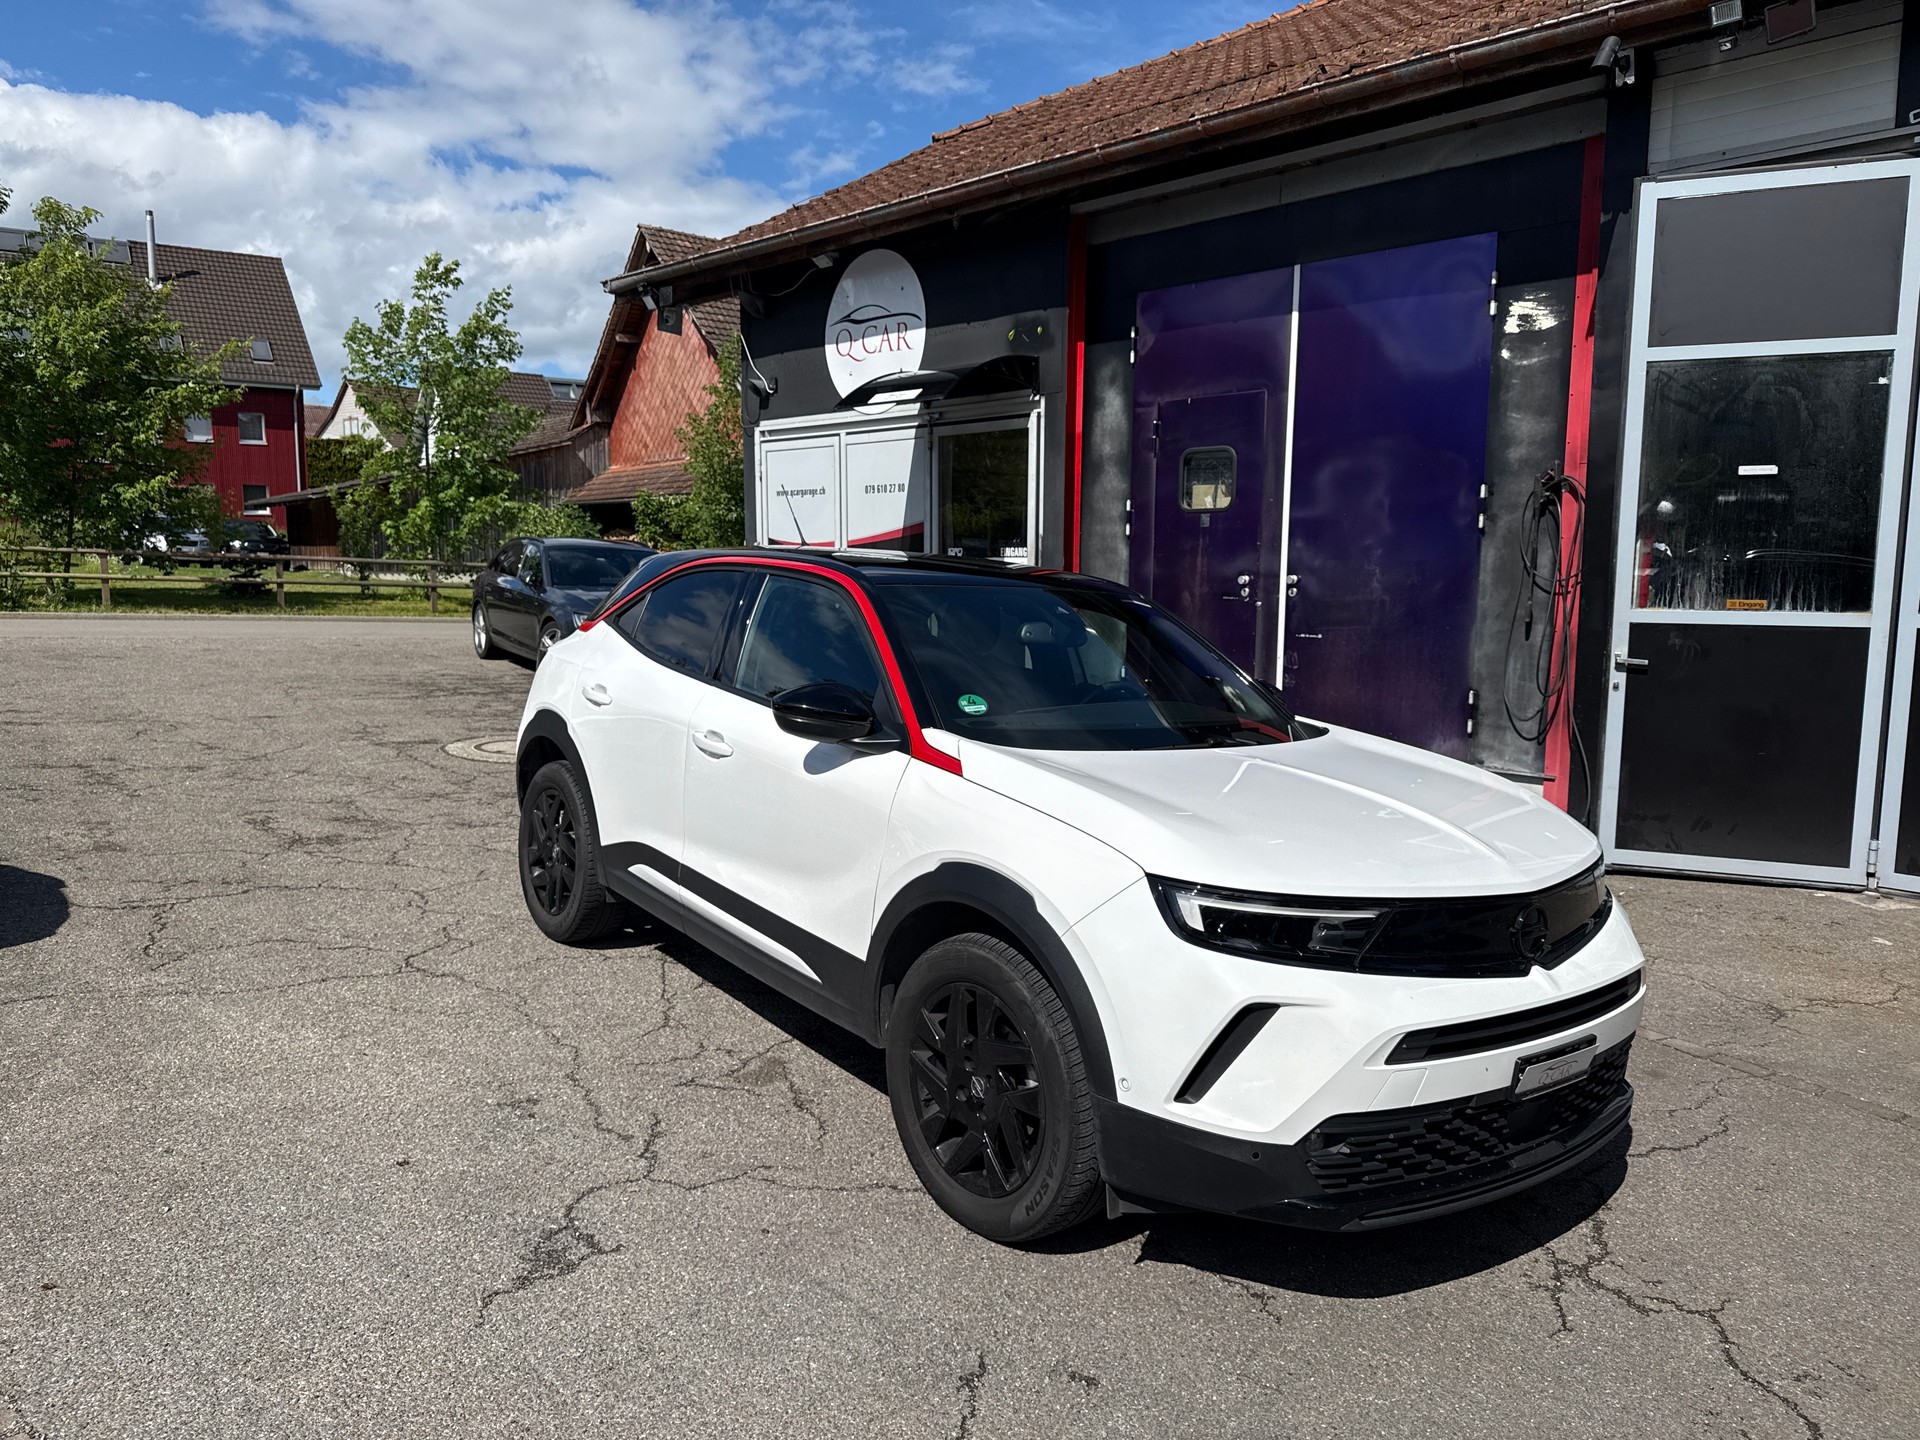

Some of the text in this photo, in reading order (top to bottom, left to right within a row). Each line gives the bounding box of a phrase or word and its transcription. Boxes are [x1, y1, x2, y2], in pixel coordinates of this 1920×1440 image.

[776, 487, 825, 498] www.qcargarage.ch
[865, 483, 905, 494] 079 610 27 80
[1000, 547, 1028, 557] EINGANG
[1738, 601, 1765, 609] Eingang
